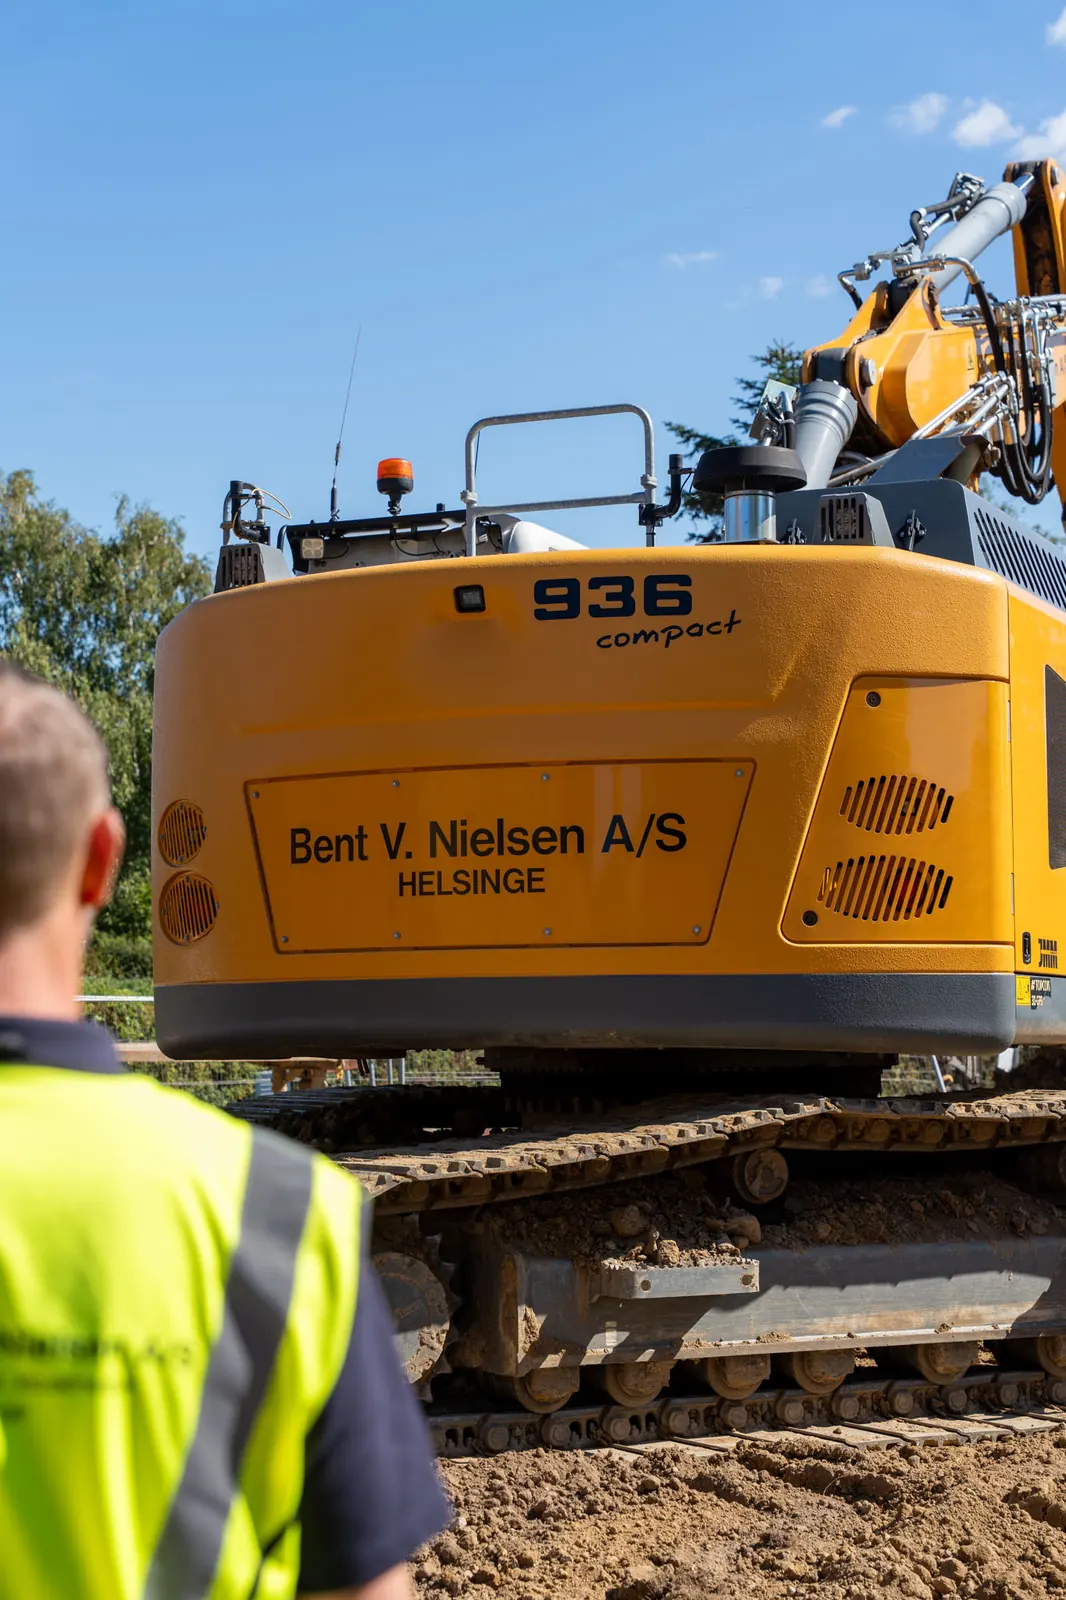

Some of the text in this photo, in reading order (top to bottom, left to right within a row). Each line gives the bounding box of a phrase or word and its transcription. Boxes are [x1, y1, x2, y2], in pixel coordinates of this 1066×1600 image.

[533, 574, 693, 621] 936
[596, 609, 742, 649] compact
[290, 812, 688, 865] Bent V. Nielsen A/S
[399, 867, 546, 897] HELSINGE
